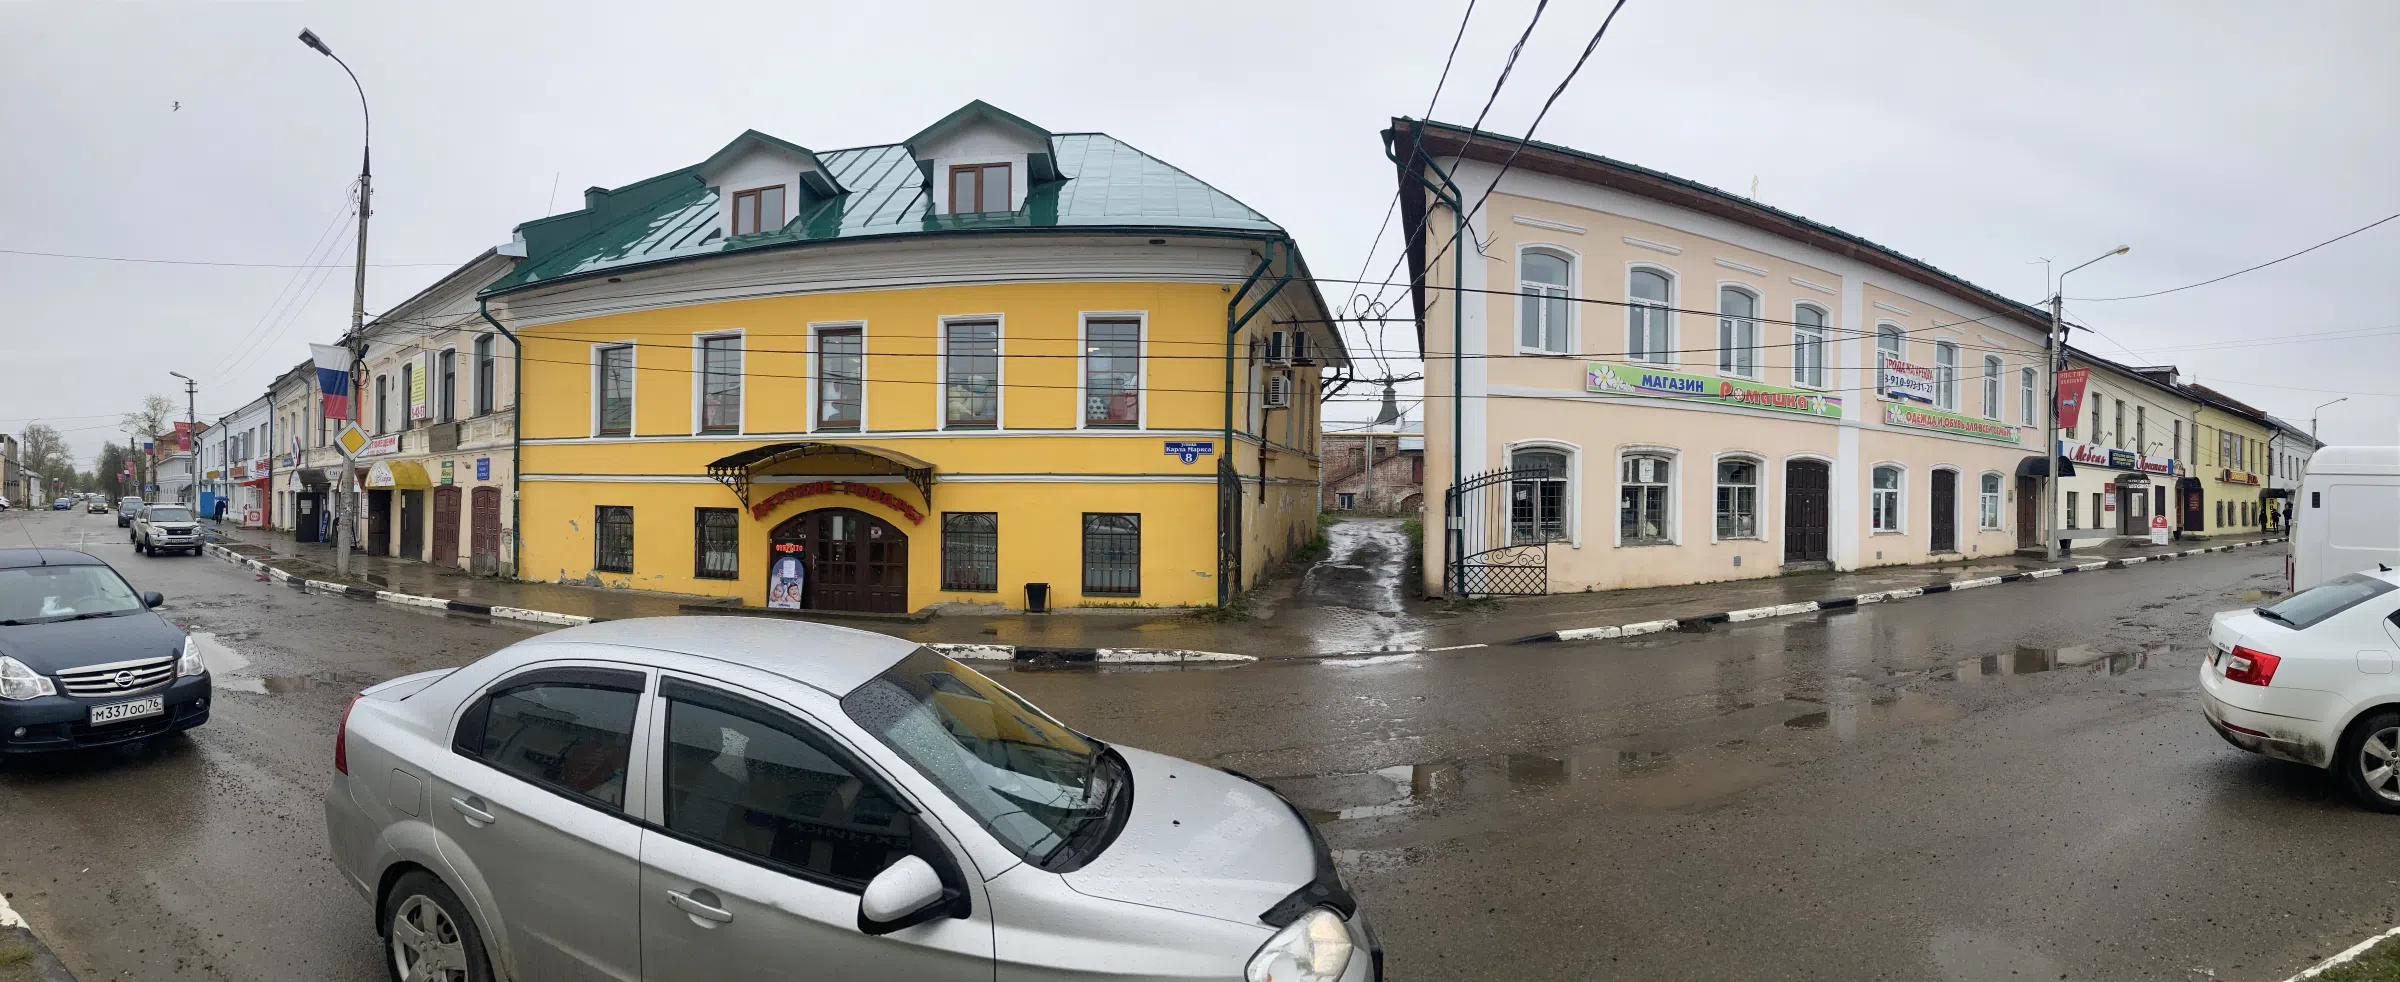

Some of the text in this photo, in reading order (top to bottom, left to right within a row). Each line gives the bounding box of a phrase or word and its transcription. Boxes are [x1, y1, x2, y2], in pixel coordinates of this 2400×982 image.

[1641, 374, 1704, 393] МАГАЗИН
[1905, 411, 1936, 426] ОДЕЖДА
[1938, 416, 1942, 426] И
[1944, 417, 1965, 430] ОБУВЬ
[1965, 421, 1978, 432] ДЛЯ
[1993, 426, 2011, 437] СЕМЬИ
[1185, 453, 1193, 462] 8
[2069, 444, 2107, 465] Мебель
[841, 480, 925, 527] ТОВАРЫ
[775, 544, 803, 552] ОТКРЫТО
[148, 698, 159, 709] 76
